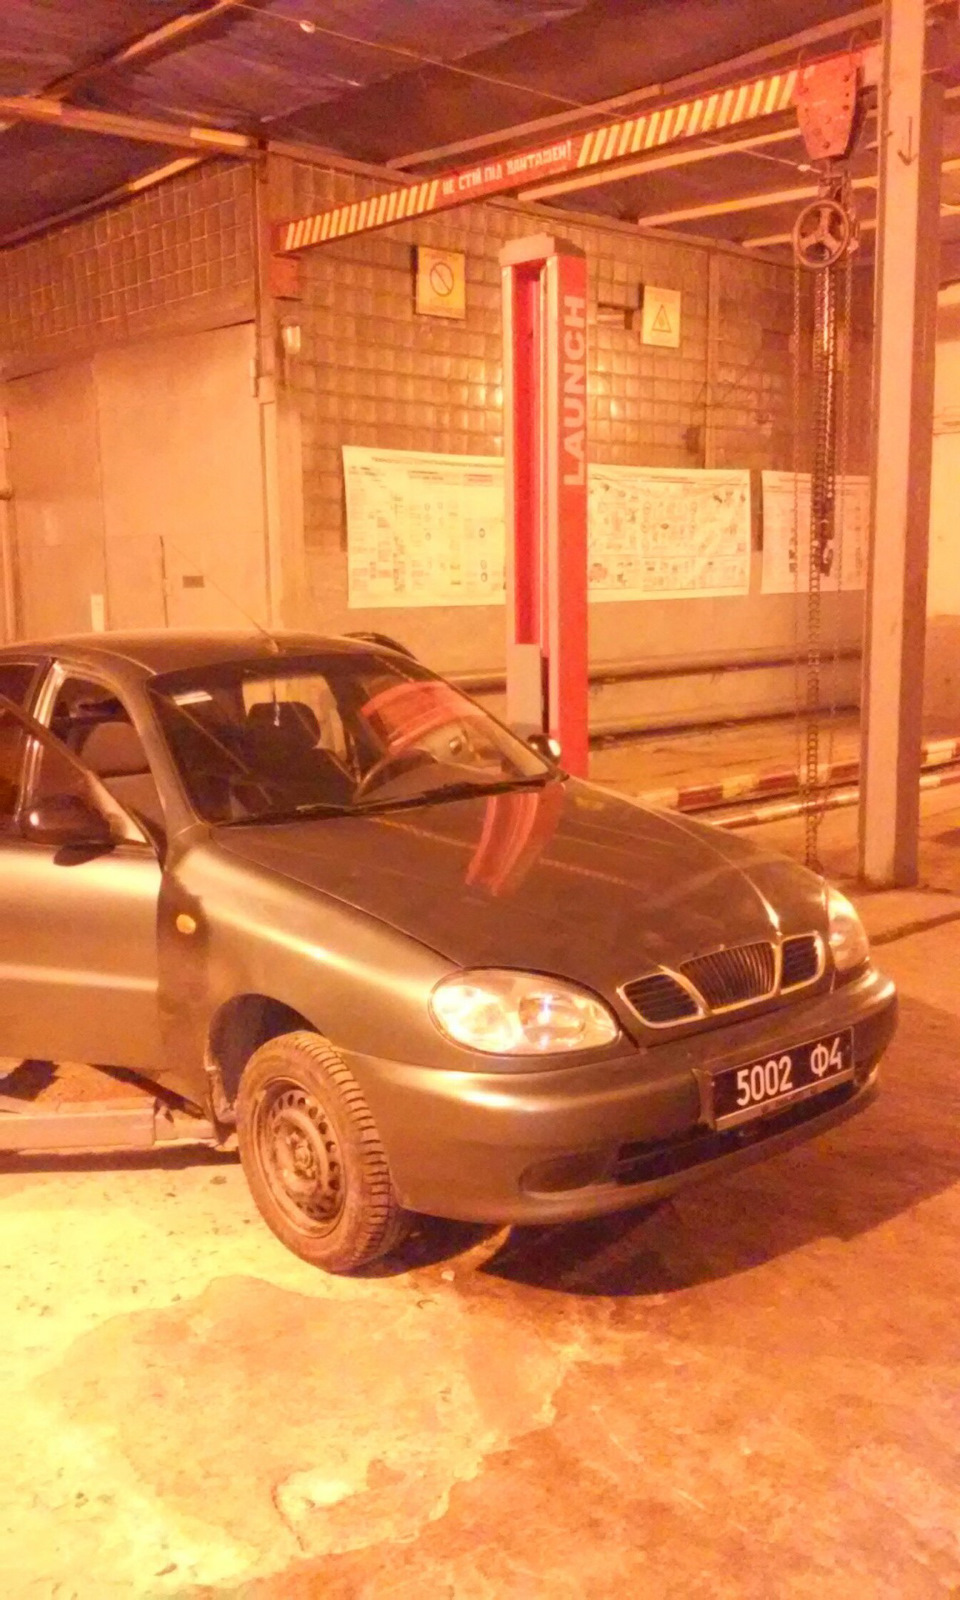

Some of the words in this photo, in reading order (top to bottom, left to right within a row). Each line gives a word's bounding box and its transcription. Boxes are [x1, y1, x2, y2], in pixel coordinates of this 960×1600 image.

[442, 178, 455, 195] НЕ
[564, 295, 585, 486] LAUNCH
[736, 1055, 793, 1106] 5002
[810, 1037, 843, 1077] Ф4
